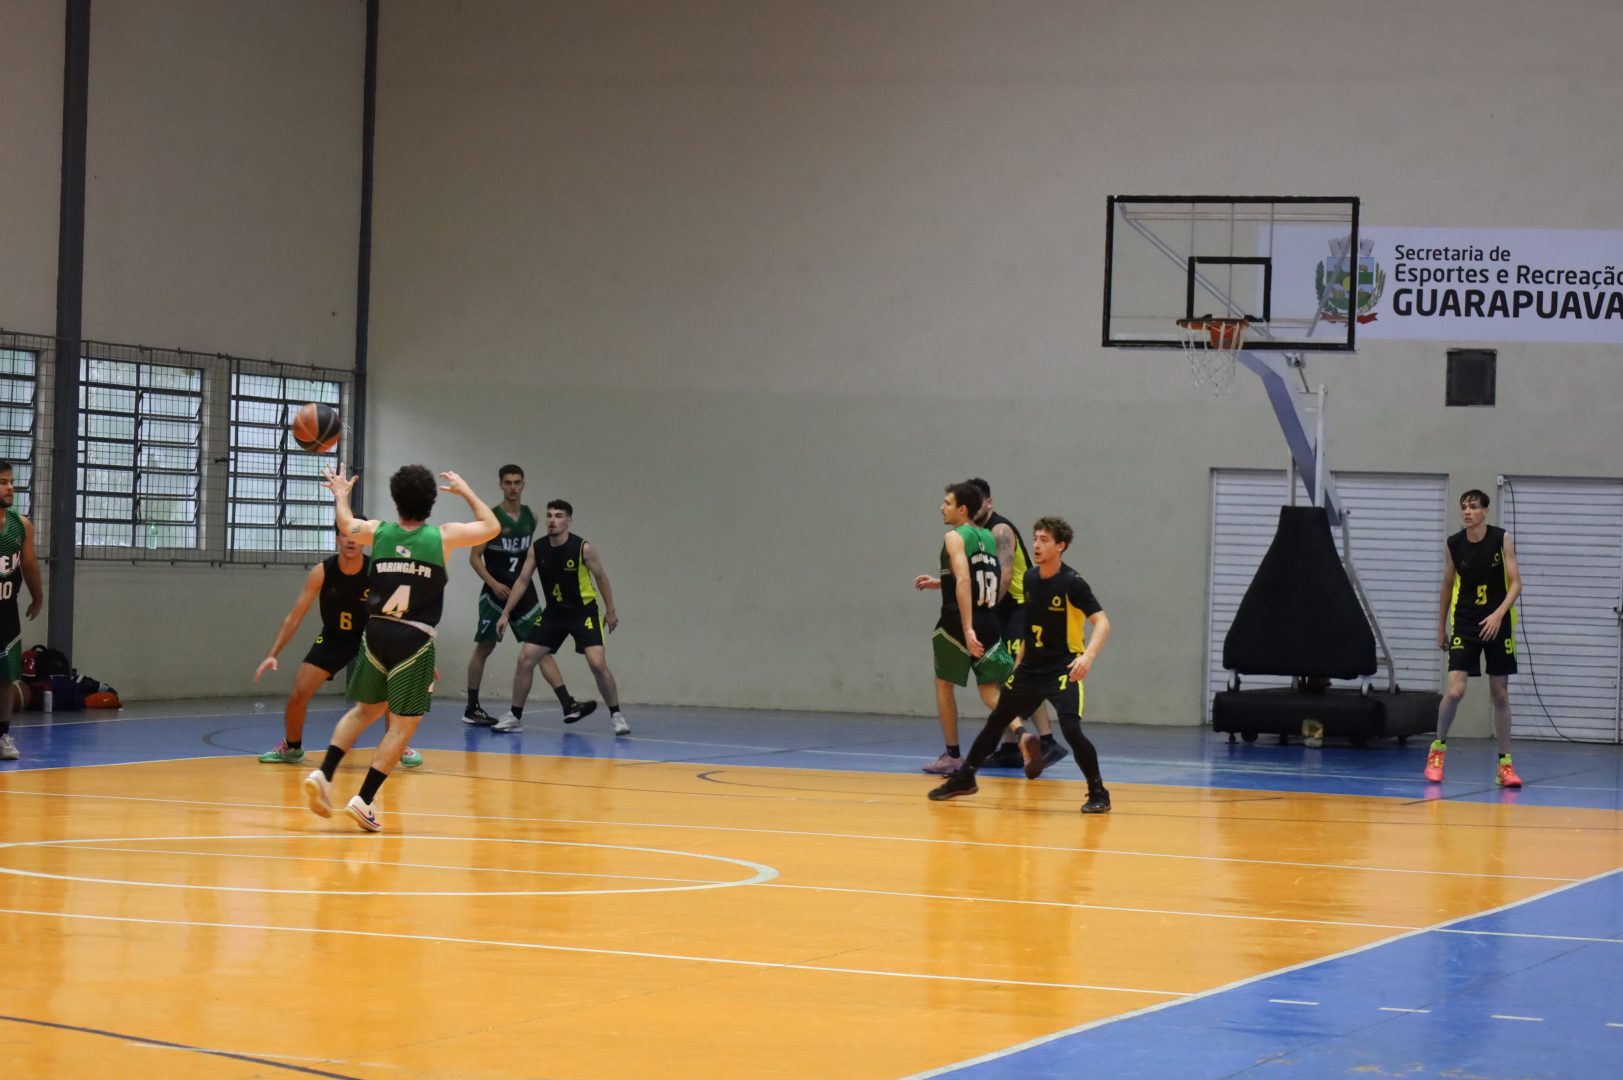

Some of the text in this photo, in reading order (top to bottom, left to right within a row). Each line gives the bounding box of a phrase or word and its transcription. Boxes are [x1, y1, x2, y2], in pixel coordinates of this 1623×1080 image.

[1394, 245, 1511, 262] Secretaria de
[1394, 264, 1489, 286] Esportes
[1496, 270, 1509, 283] e
[1392, 288, 1623, 320] GUARAPUAVA
[509, 557, 519, 572] 7
[552, 583, 563, 602] 4
[381, 584, 411, 619] 4
[339, 611, 353, 631] 6
[482, 619, 492, 634] 7
[584, 616, 594, 630] 4
[1031, 624, 1044, 648] 7
[1007, 638, 1021, 655] 14
[1504, 638, 1513, 654] 9
[1058, 674, 1068, 690] 7
